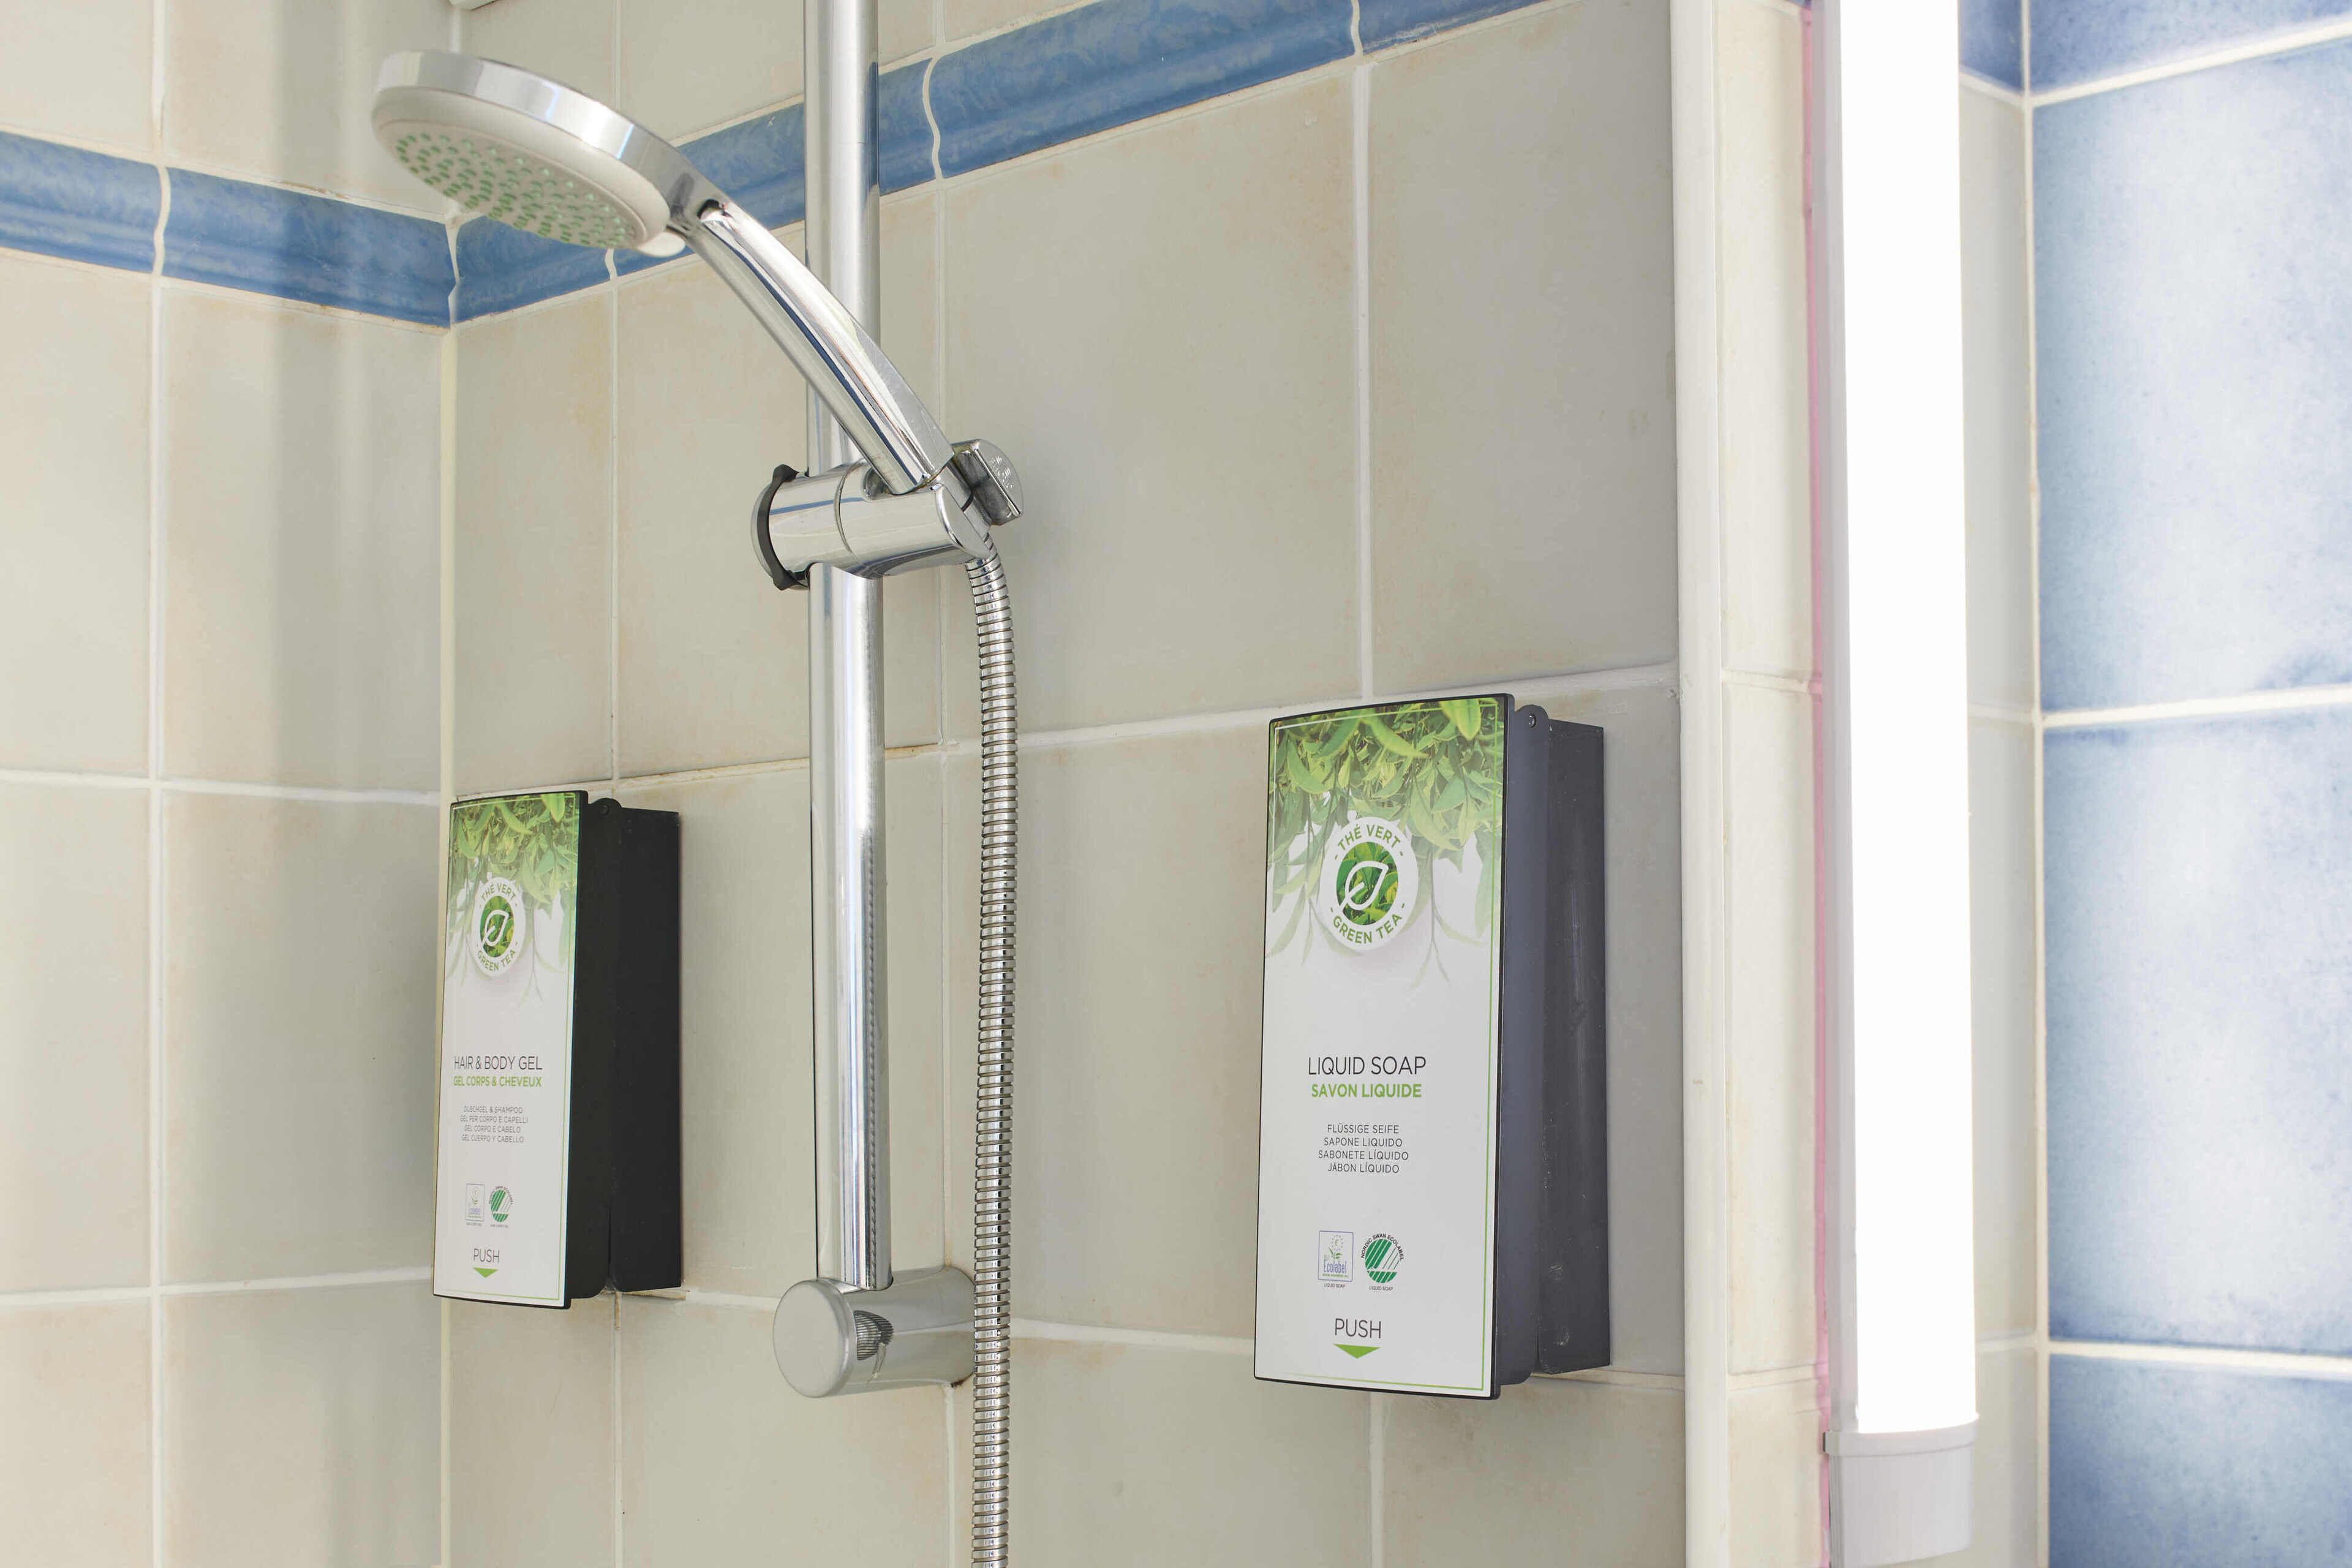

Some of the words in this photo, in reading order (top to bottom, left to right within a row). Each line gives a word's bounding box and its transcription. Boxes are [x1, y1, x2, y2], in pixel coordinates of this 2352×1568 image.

[1338, 824, 1362, 850] THÉ
[1366, 824, 1400, 848] VERT
[497, 883, 516, 900] VERT
[1333, 916, 1372, 944] GREEN
[1376, 913, 1402, 939] TEA
[477, 951, 499, 971] GREEN
[501, 950, 516, 967] TEA
[454, 1056, 473, 1069] HAIR
[475, 1056, 481, 1069] &
[484, 1056, 515, 1069] BODY
[519, 1056, 543, 1070] GEL
[1308, 1057, 1365, 1075] LIQUID
[1371, 1056, 1427, 1075] SOAP
[453, 1076, 465, 1086] GEL
[466, 1076, 489, 1086] CORPS
[492, 1076, 497, 1086] &
[499, 1076, 542, 1087] CHEVEUX
[1311, 1084, 1357, 1098] SAVON
[1362, 1084, 1422, 1098] LIQUIDE
[1327, 1123, 1370, 1133] FLÜSSIGE
[1372, 1125, 1400, 1134] SEIFE
[1324, 1137, 1359, 1146] SAPONE
[1363, 1138, 1403, 1147] LIQUIDO
[1318, 1150, 1365, 1159] SABONETE
[1368, 1149, 1409, 1160] LÍQUIDO
[1360, 1162, 1400, 1173] LÍQUIDO
[1360, 1238, 1373, 1259] NORDIC
[1387, 1235, 1404, 1261] ECOLABEL
[473, 1248, 500, 1264] PUSH
[1324, 1259, 1347, 1273] Ecolabel
[1335, 1318, 1381, 1338] PUSH
